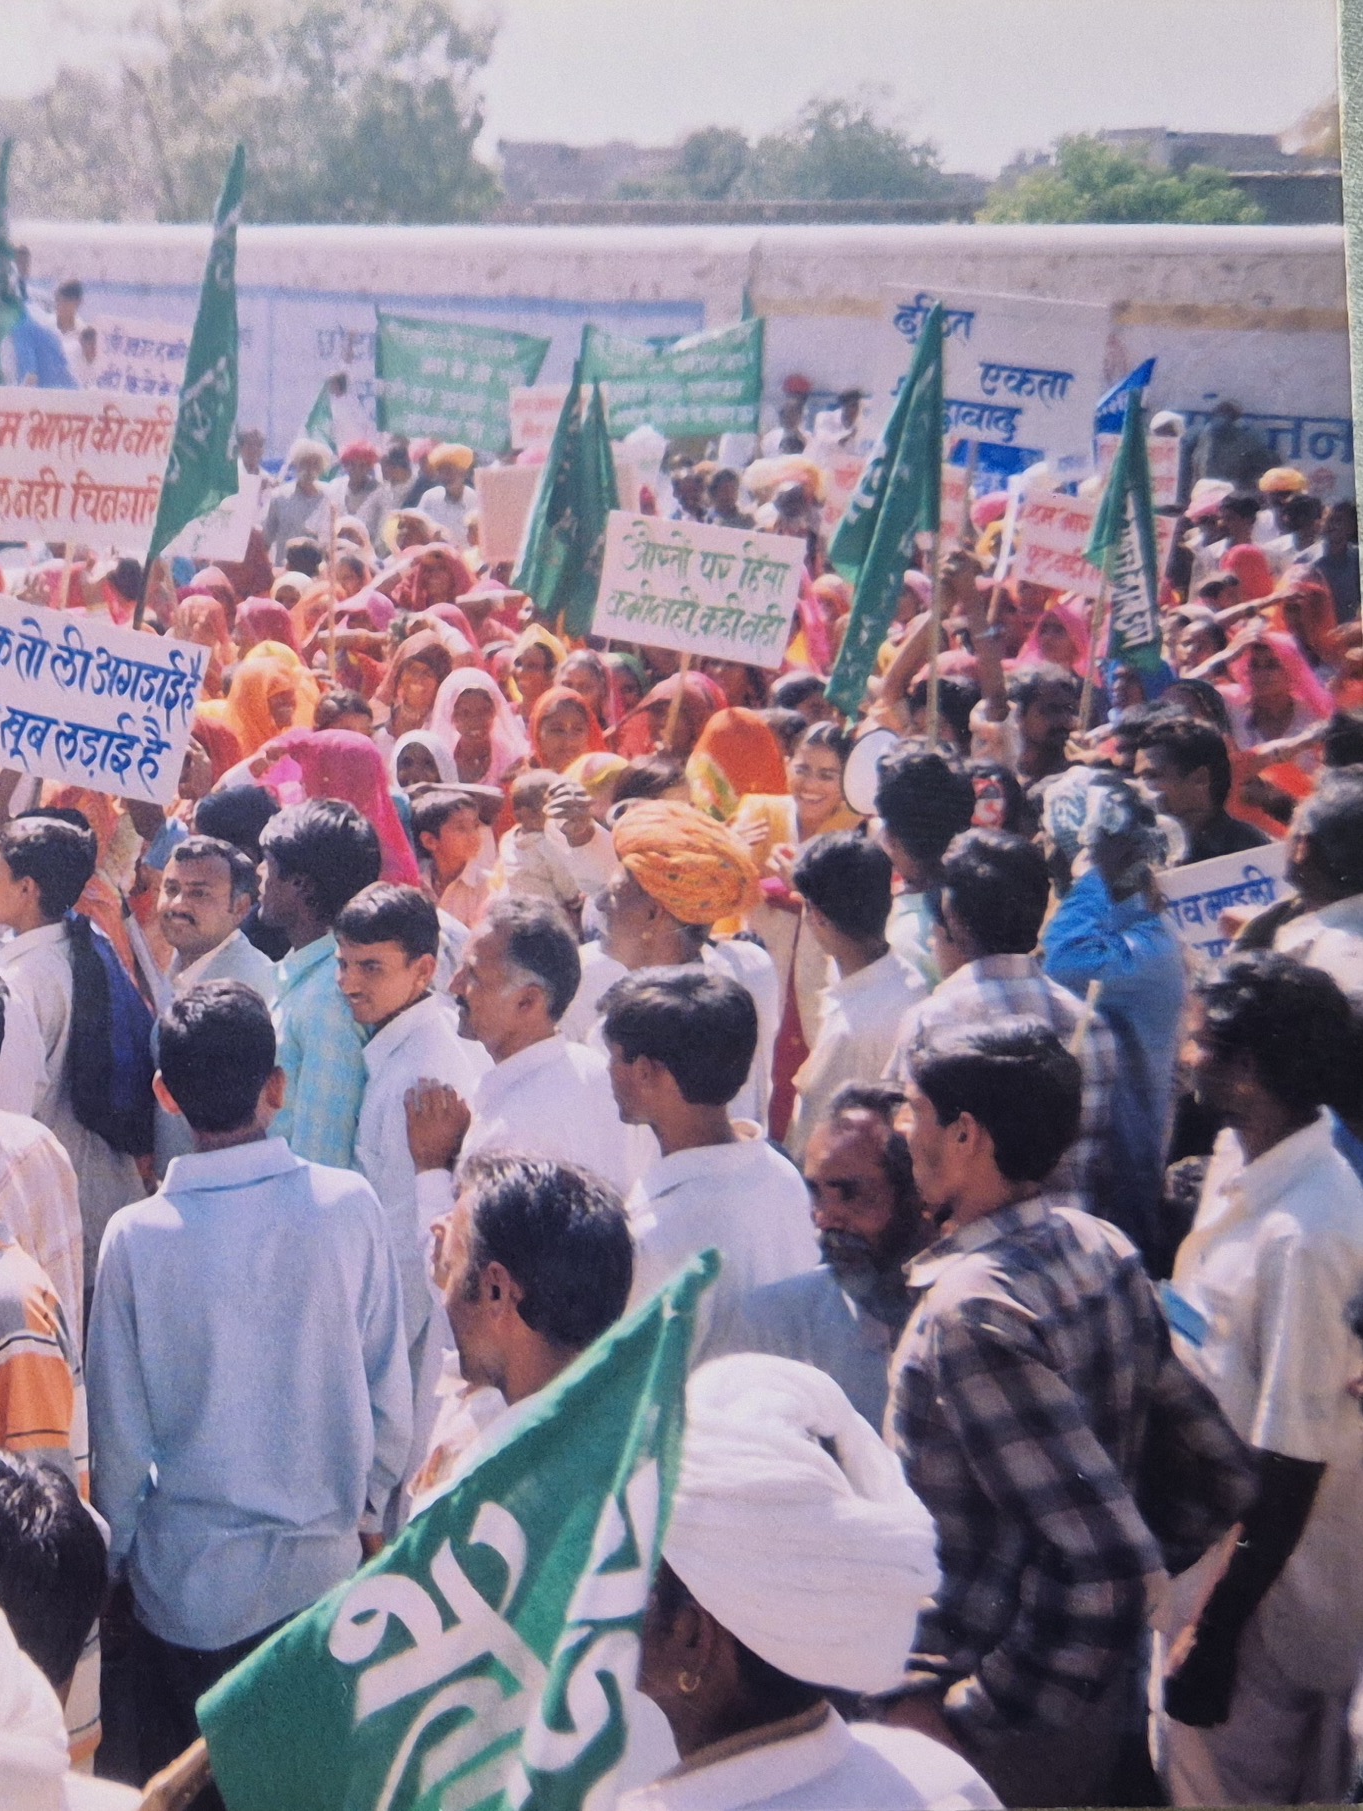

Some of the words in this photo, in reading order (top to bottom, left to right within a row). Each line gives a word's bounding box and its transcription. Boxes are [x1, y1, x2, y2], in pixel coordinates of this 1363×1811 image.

[979, 361, 1074, 408] एकता
[15, 616, 51, 682] तो
[50, 624, 94, 693] ली
[0, 706, 59, 773] खूब
[138, 714, 173, 798] है
